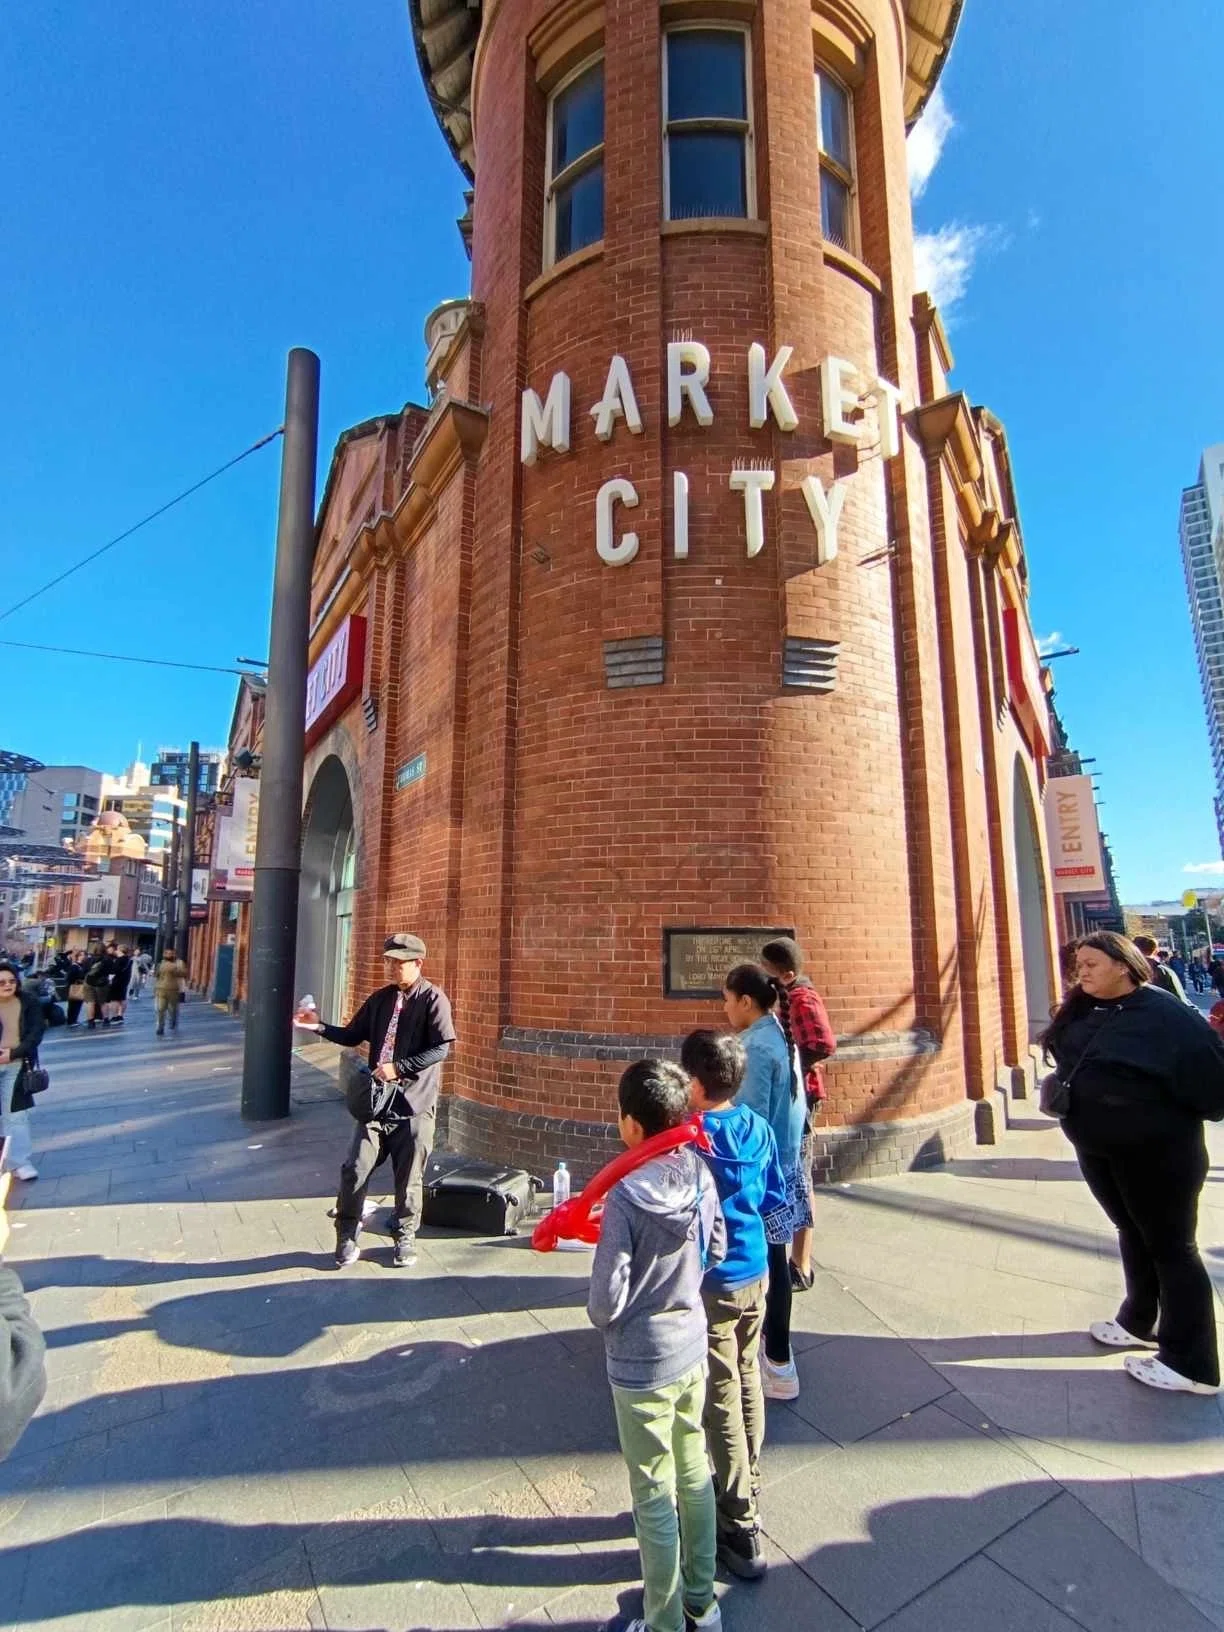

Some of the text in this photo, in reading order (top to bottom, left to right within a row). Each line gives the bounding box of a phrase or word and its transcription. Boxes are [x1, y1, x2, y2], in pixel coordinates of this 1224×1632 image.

[521, 342, 901, 466] MARKET
[596, 470, 846, 566] CITY
[1056, 791, 1082, 853] ENTRY
